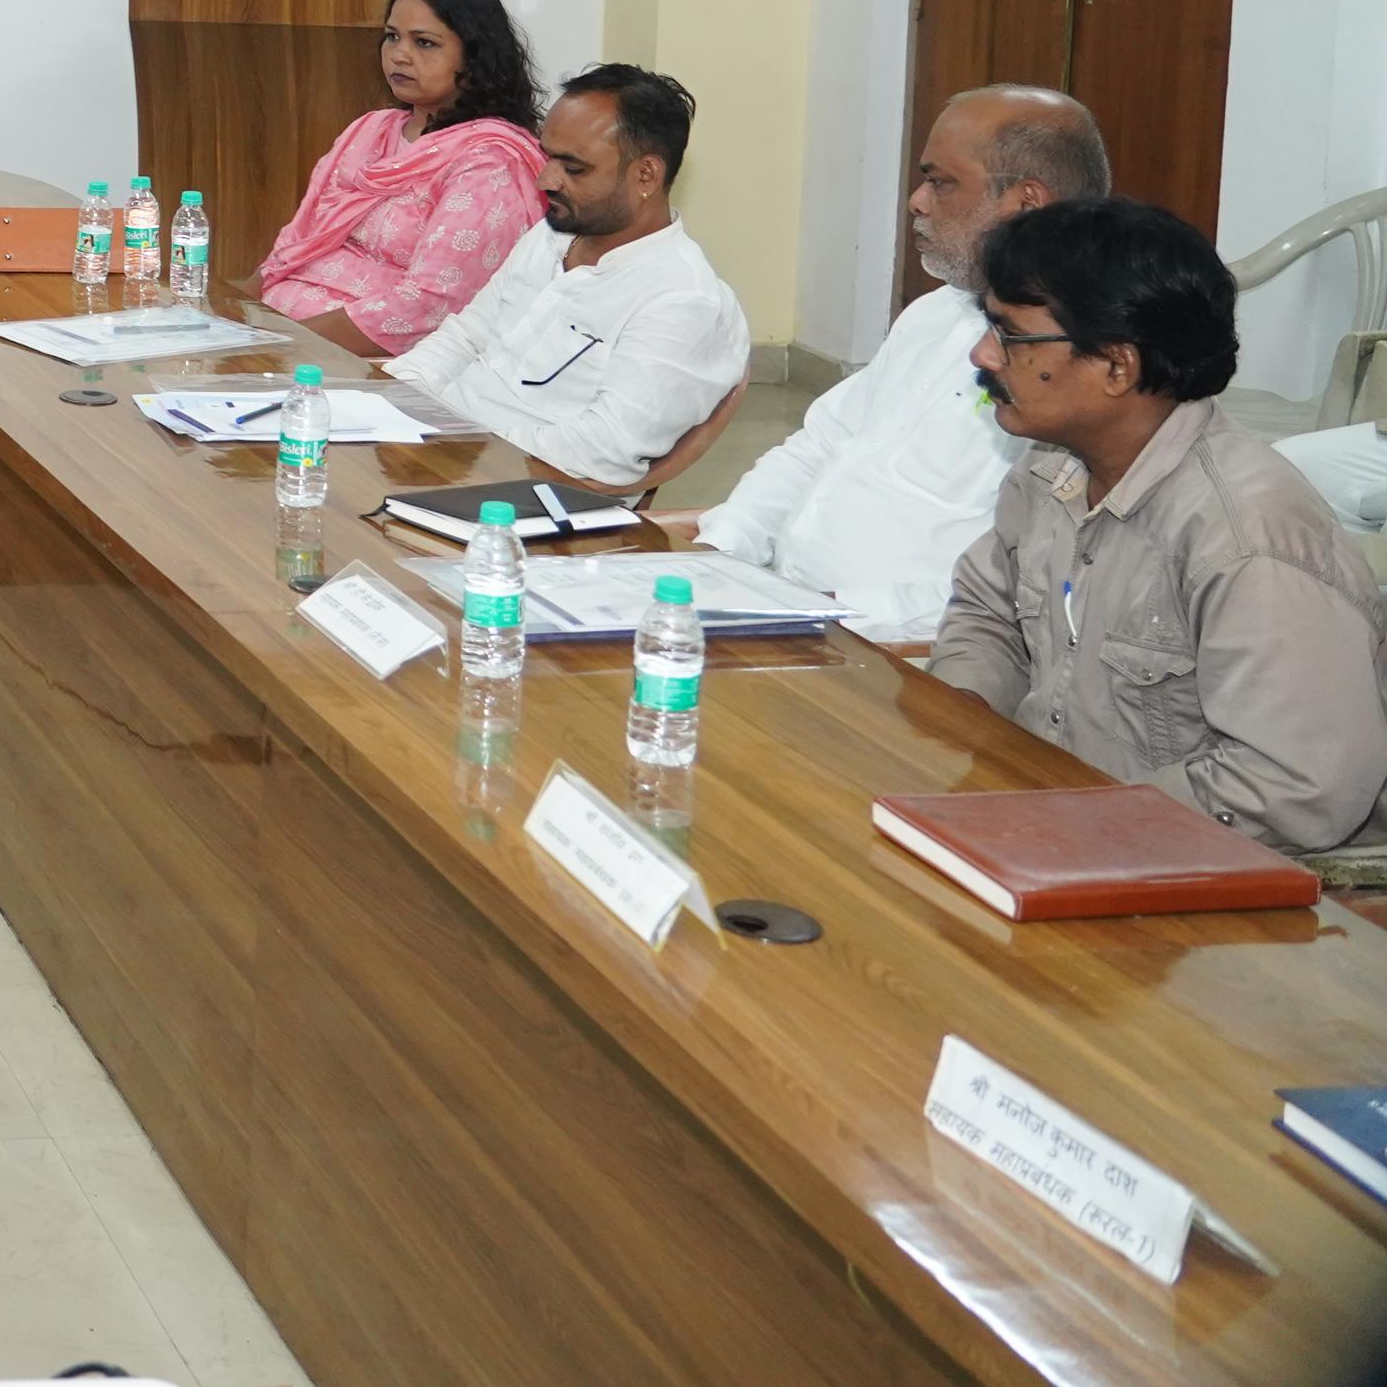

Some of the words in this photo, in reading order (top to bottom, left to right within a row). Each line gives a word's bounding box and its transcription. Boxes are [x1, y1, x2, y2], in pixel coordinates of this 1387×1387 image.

[928, 1099, 986, 1144] सहायक
[990, 1139, 1079, 1206] महाप्रबंधक
[967, 1074, 990, 1102] श्री
[995, 1093, 1048, 1138] मनोज
[1046, 1126, 1099, 1171] कुमार
